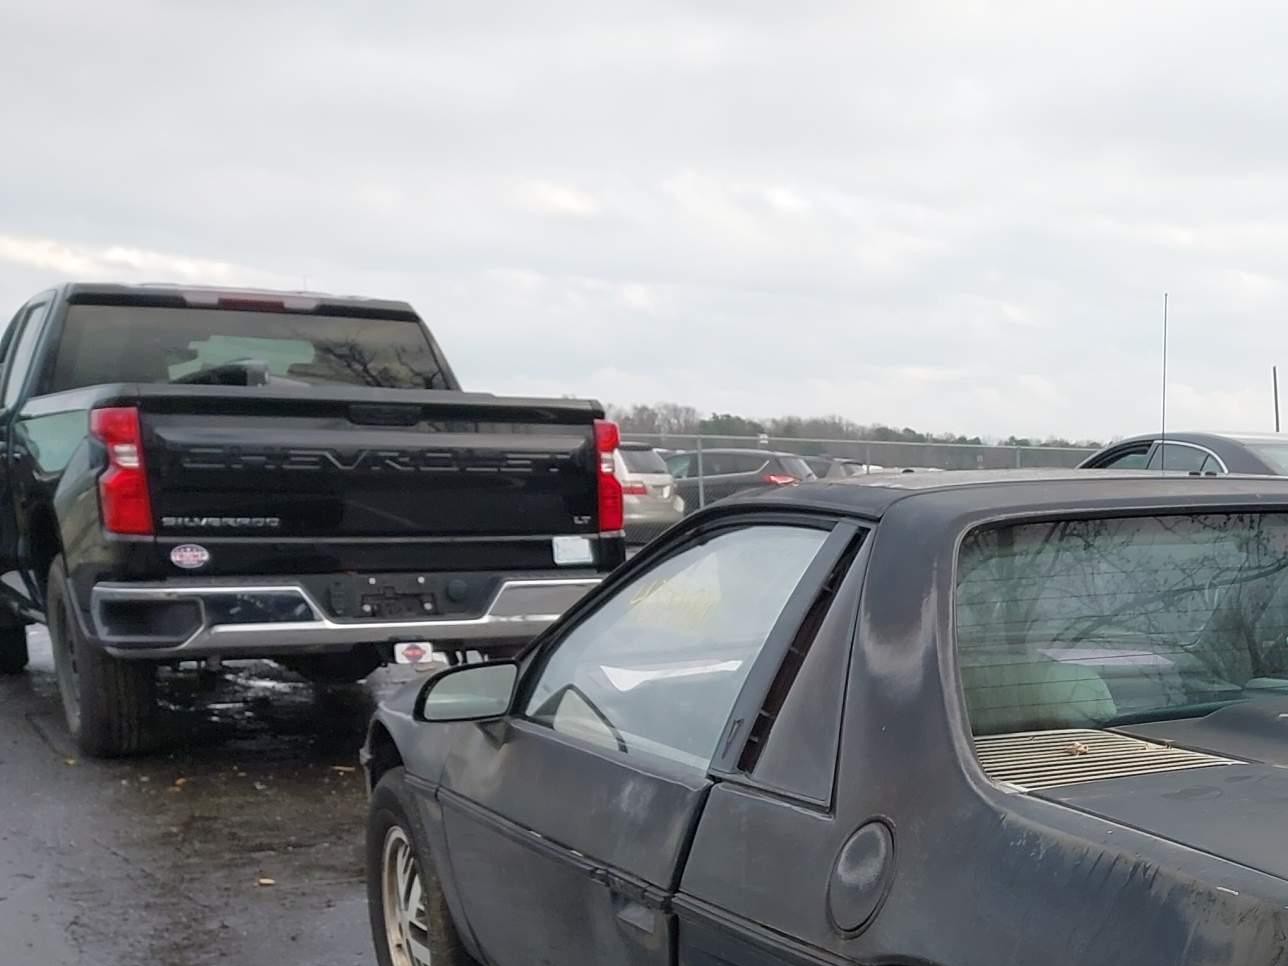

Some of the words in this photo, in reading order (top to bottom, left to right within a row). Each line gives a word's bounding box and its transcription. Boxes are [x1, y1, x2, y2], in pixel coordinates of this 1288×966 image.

[182, 447, 572, 473] CHEVROLET
[162, 516, 280, 527] SILVERADO
[573, 515, 591, 524] LT
